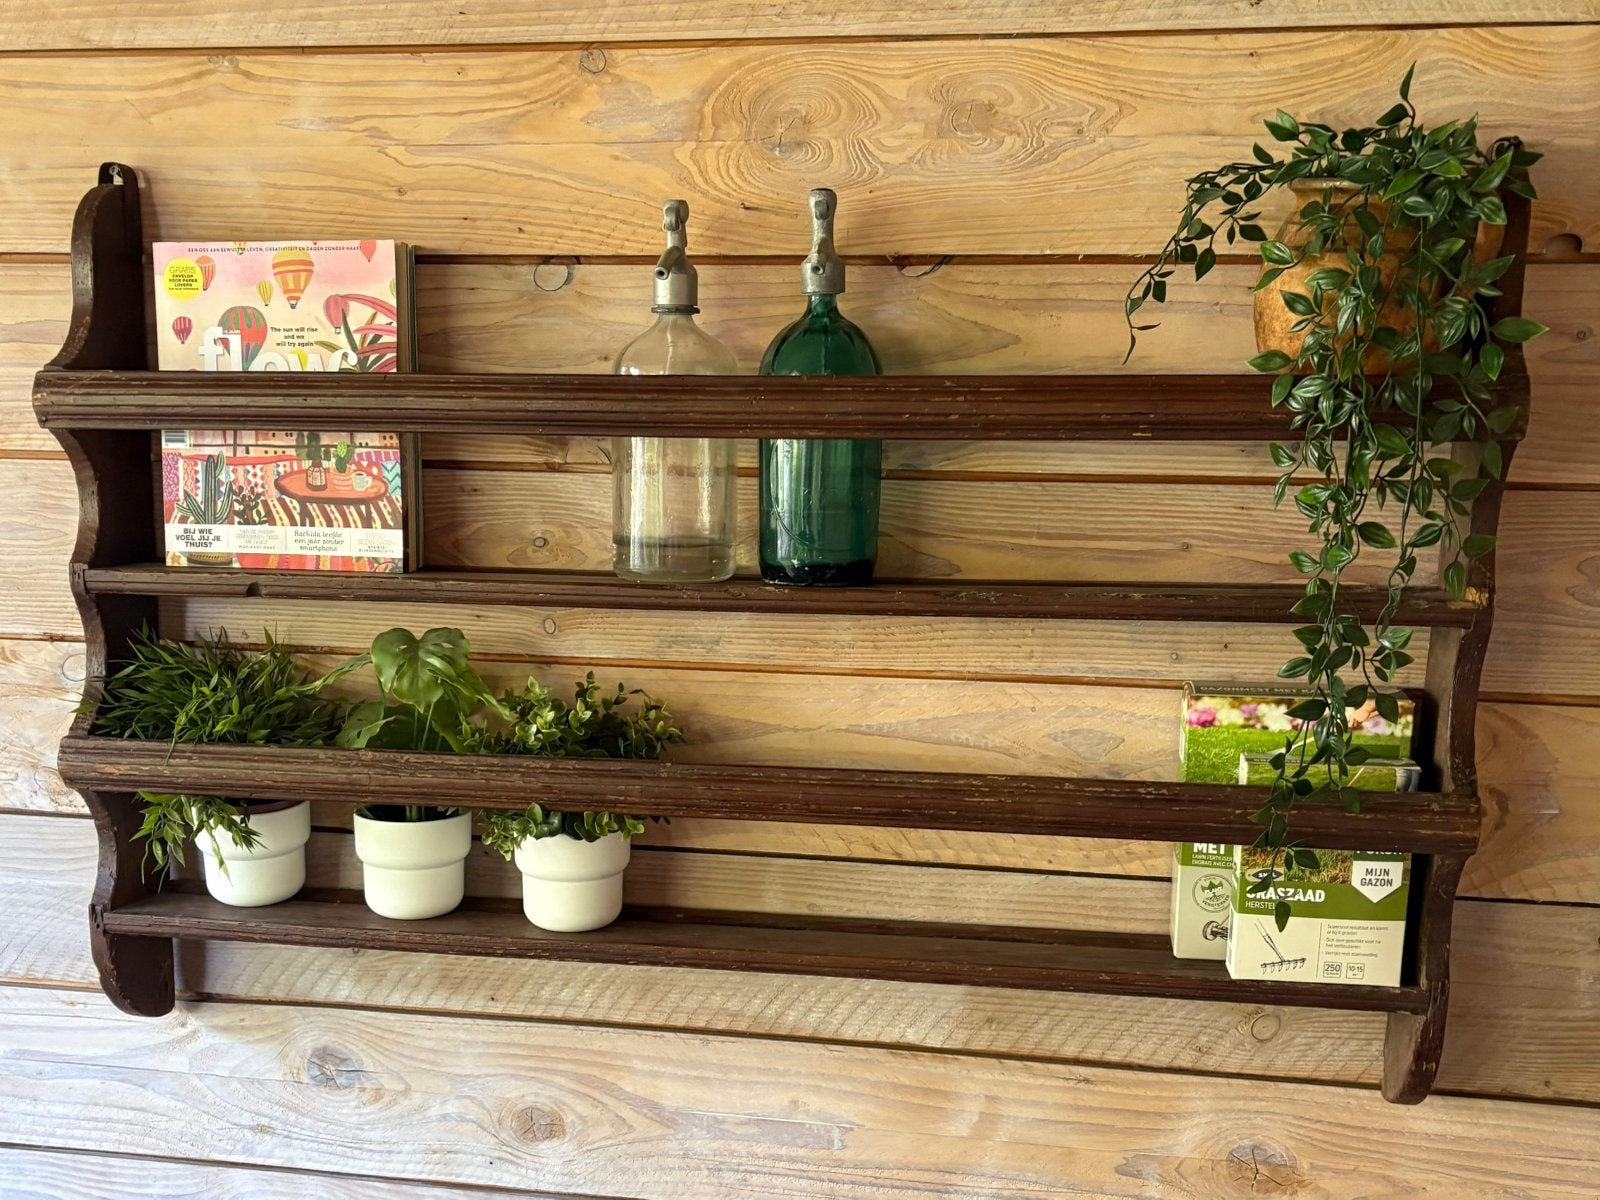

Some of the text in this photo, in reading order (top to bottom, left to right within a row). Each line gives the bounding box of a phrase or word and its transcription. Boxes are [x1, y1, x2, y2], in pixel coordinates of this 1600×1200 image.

[169, 266, 196, 274] GRATIS
[183, 527, 196, 535] BIJ
[322, 531, 342, 539] leefde
[1365, 867, 1390, 877] MIJN
[1360, 877, 1393, 887] GAZON
[1204, 886, 1223, 896] PLANT
[1325, 963, 1341, 973] 250
